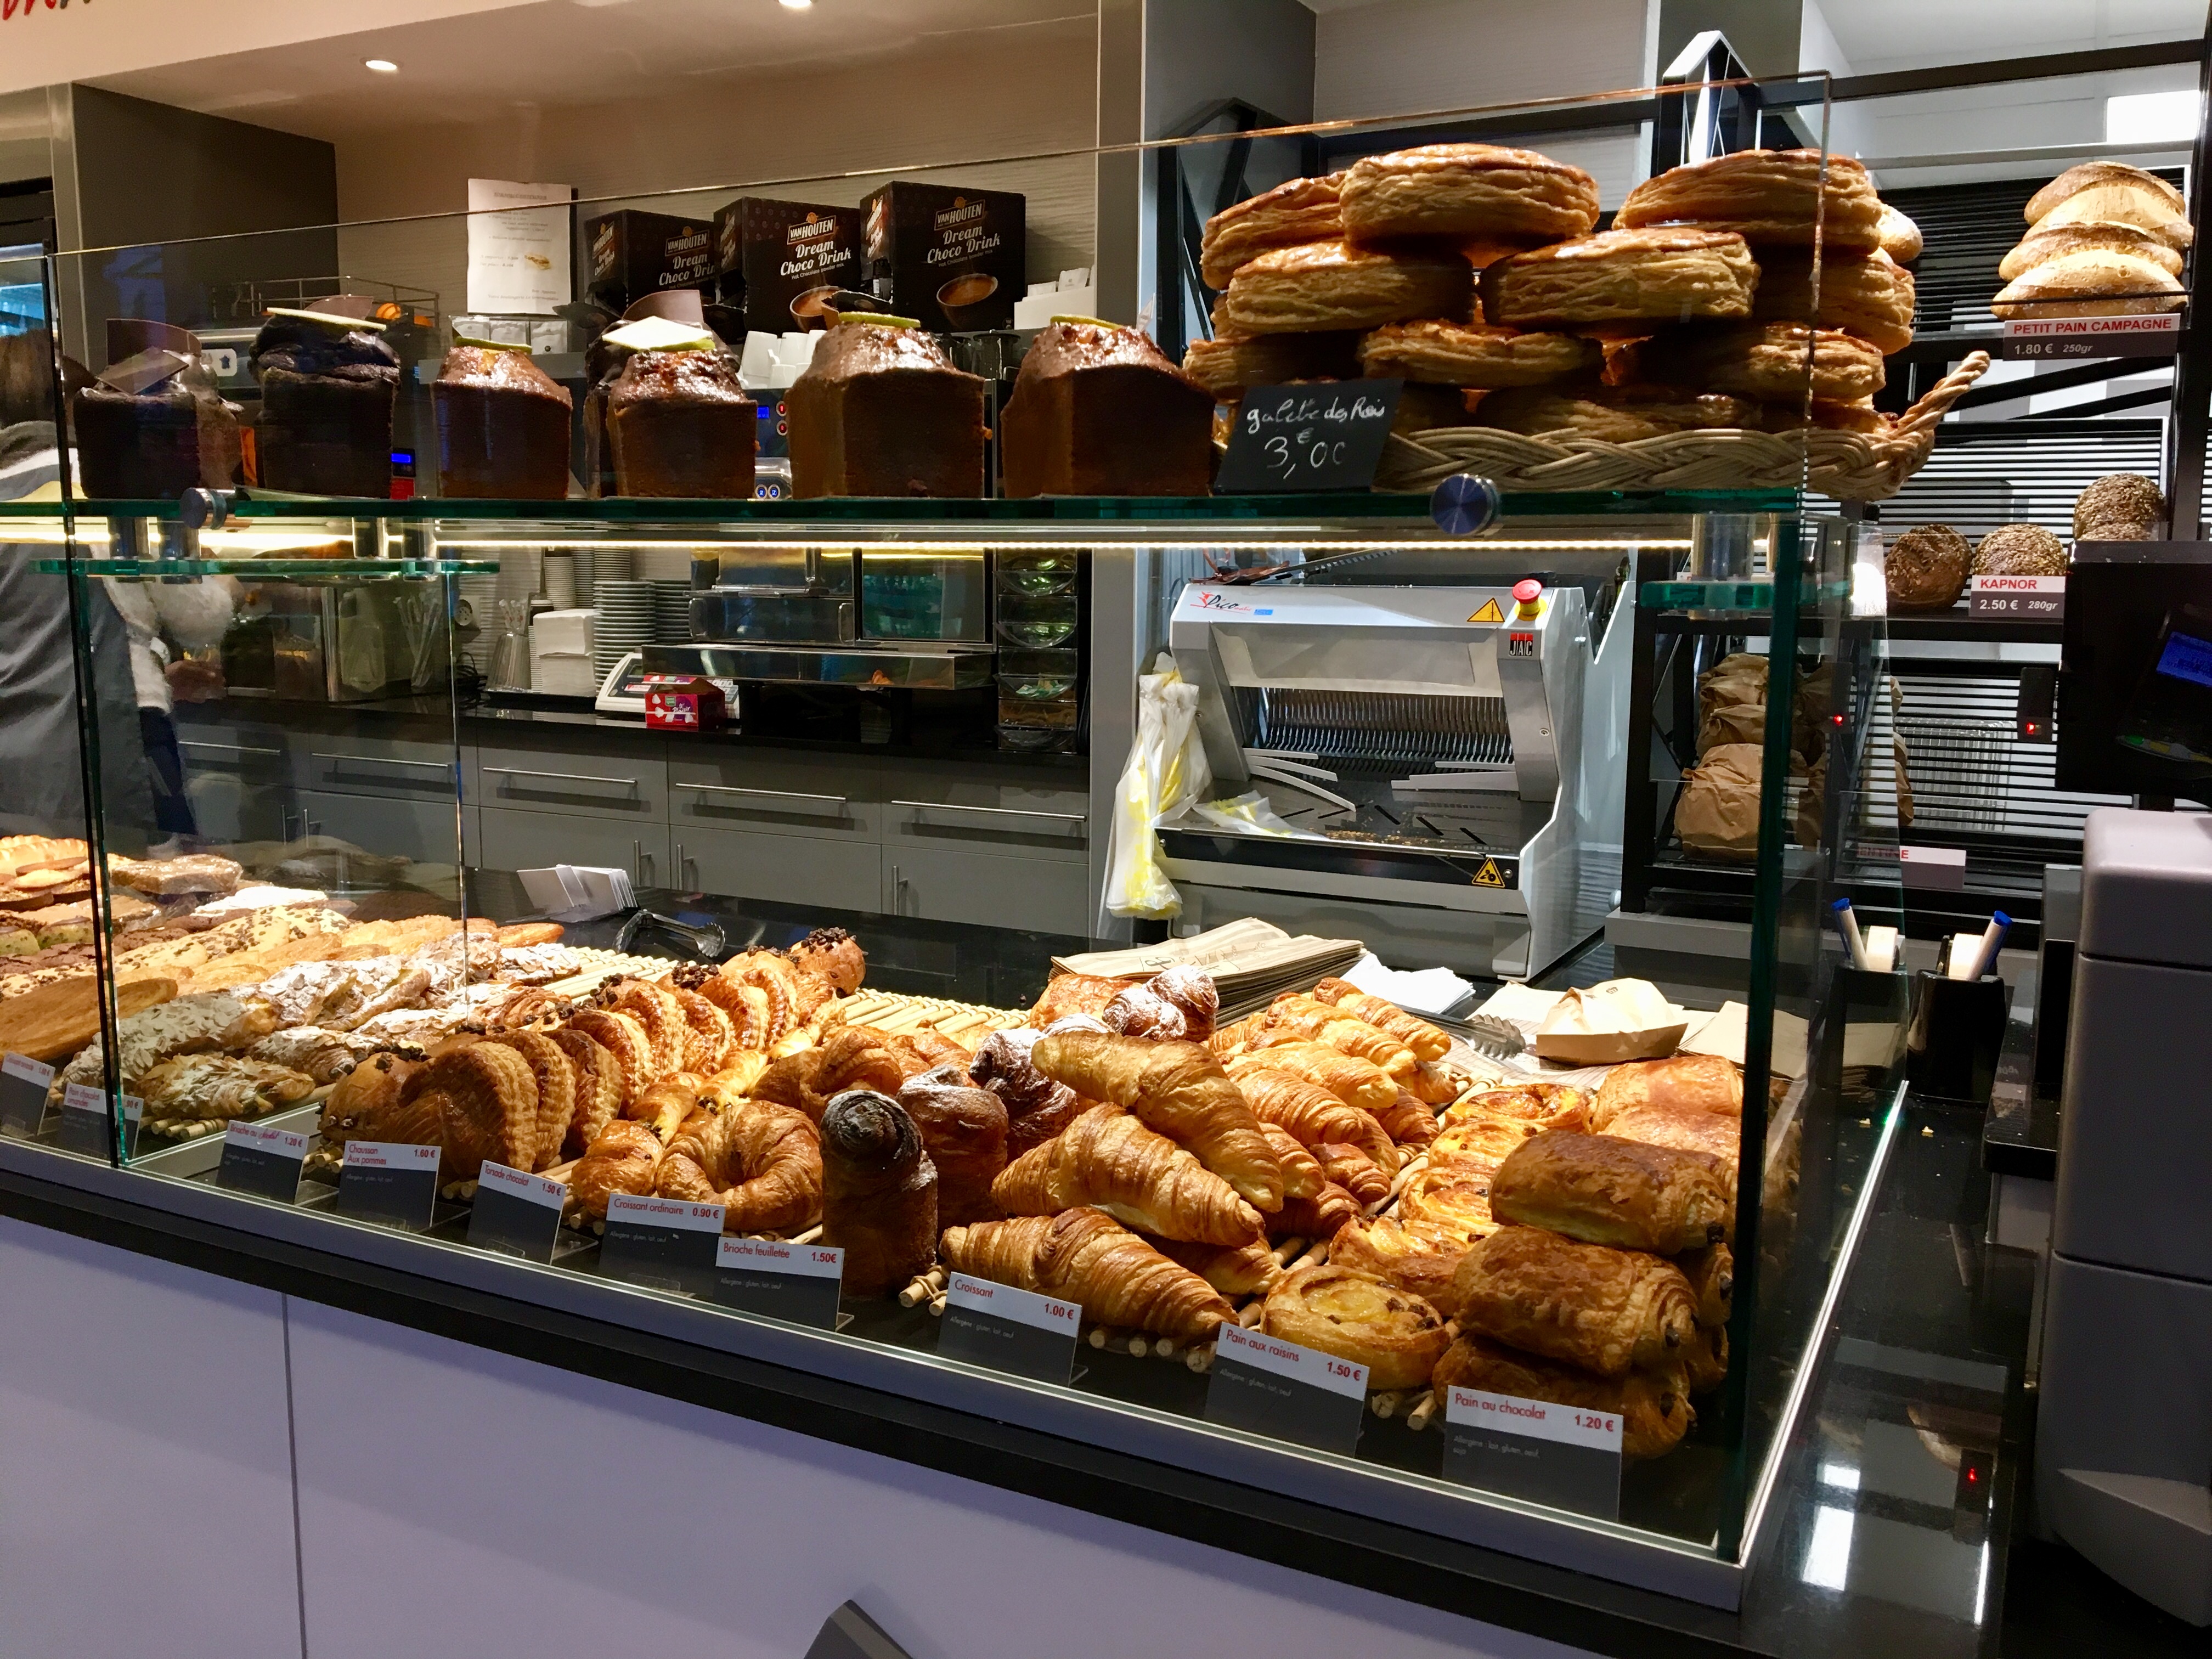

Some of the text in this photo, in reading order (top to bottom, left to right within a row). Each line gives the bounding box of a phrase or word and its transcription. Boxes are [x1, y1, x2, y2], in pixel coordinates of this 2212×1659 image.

[943, 226, 983, 245] Dream
[795, 240, 834, 258] Dream
[927, 233, 1000, 263] Choco Drink
[673, 254, 707, 269] Dream
[781, 247, 851, 276] Choco Drink
[659, 263, 715, 286] Choco Drin
[2013, 319, 2172, 334] PETIT PAIN CAMPAGNE
[2015, 343, 2093, 355] 1.80 € 250gr
[1980, 579, 2037, 590] KAPNOR
[1979, 599, 2058, 612] 2.50 € 280gr
[1510, 640, 1532, 656] JAC
[230, 1124, 249, 1135] Brioche
[285, 1137, 297, 1146] 1.20
[348, 1144, 436, 1158] Chausson 1.60 €
[361, 1157, 387, 1166] pommes
[485, 1165, 562, 1196] Torsade chocolat 1.50 €
[614, 1198, 719, 1218] Croissant ordinaire 0.90 €
[724, 1243, 753, 1255] Brioche
[755, 1244, 790, 1259] feuilletée
[955, 1279, 1074, 1319] Croissant 1.00 €
[1226, 1329, 1361, 1381] Pain aux raisins 1.50 €
[1455, 1393, 1613, 1432] Pain au chocolat 1.20 €
